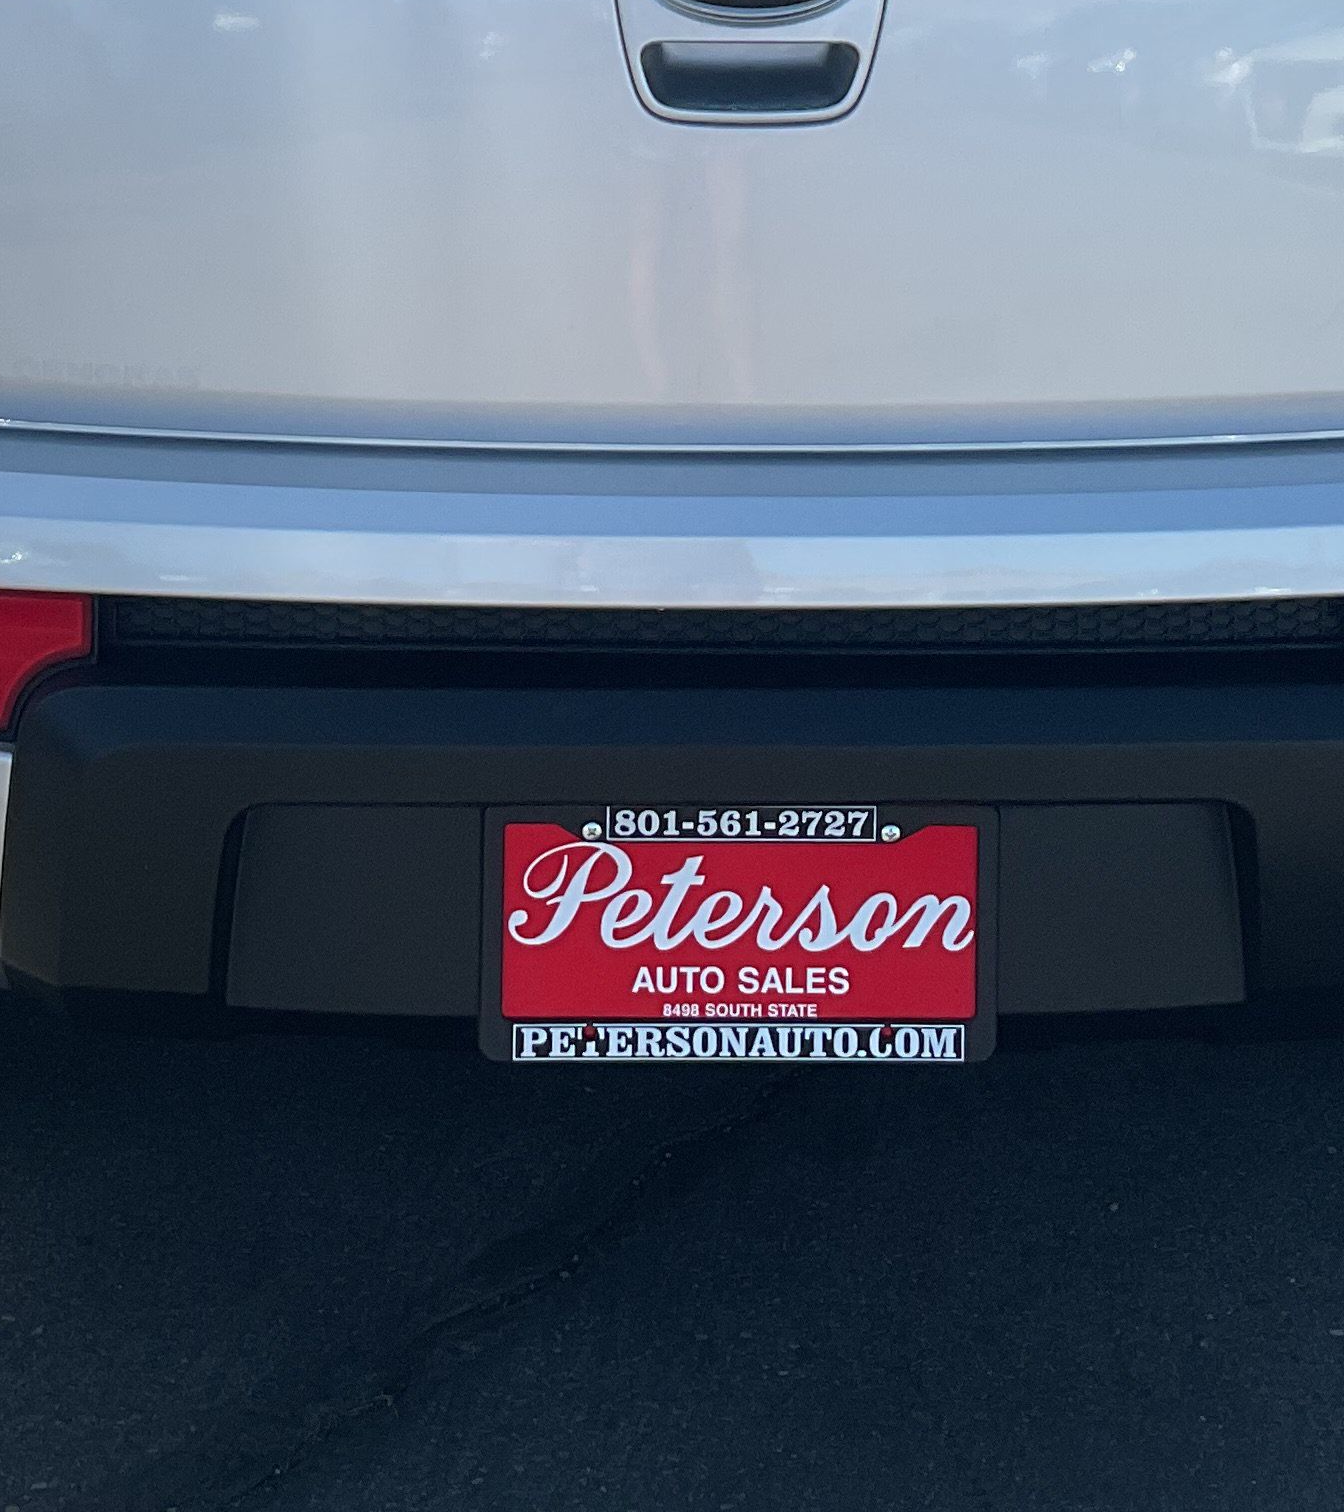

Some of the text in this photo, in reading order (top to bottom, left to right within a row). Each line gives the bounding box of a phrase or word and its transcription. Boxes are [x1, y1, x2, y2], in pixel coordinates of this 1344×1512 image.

[613, 809, 869, 839] 801-561-2727
[508, 841, 975, 953] Peterson
[631, 965, 850, 995] AUTO SALES
[662, 1003, 818, 1018] 8498 SOUTH STATE
[519, 1027, 958, 1058] PETERSONAUTO.COM
